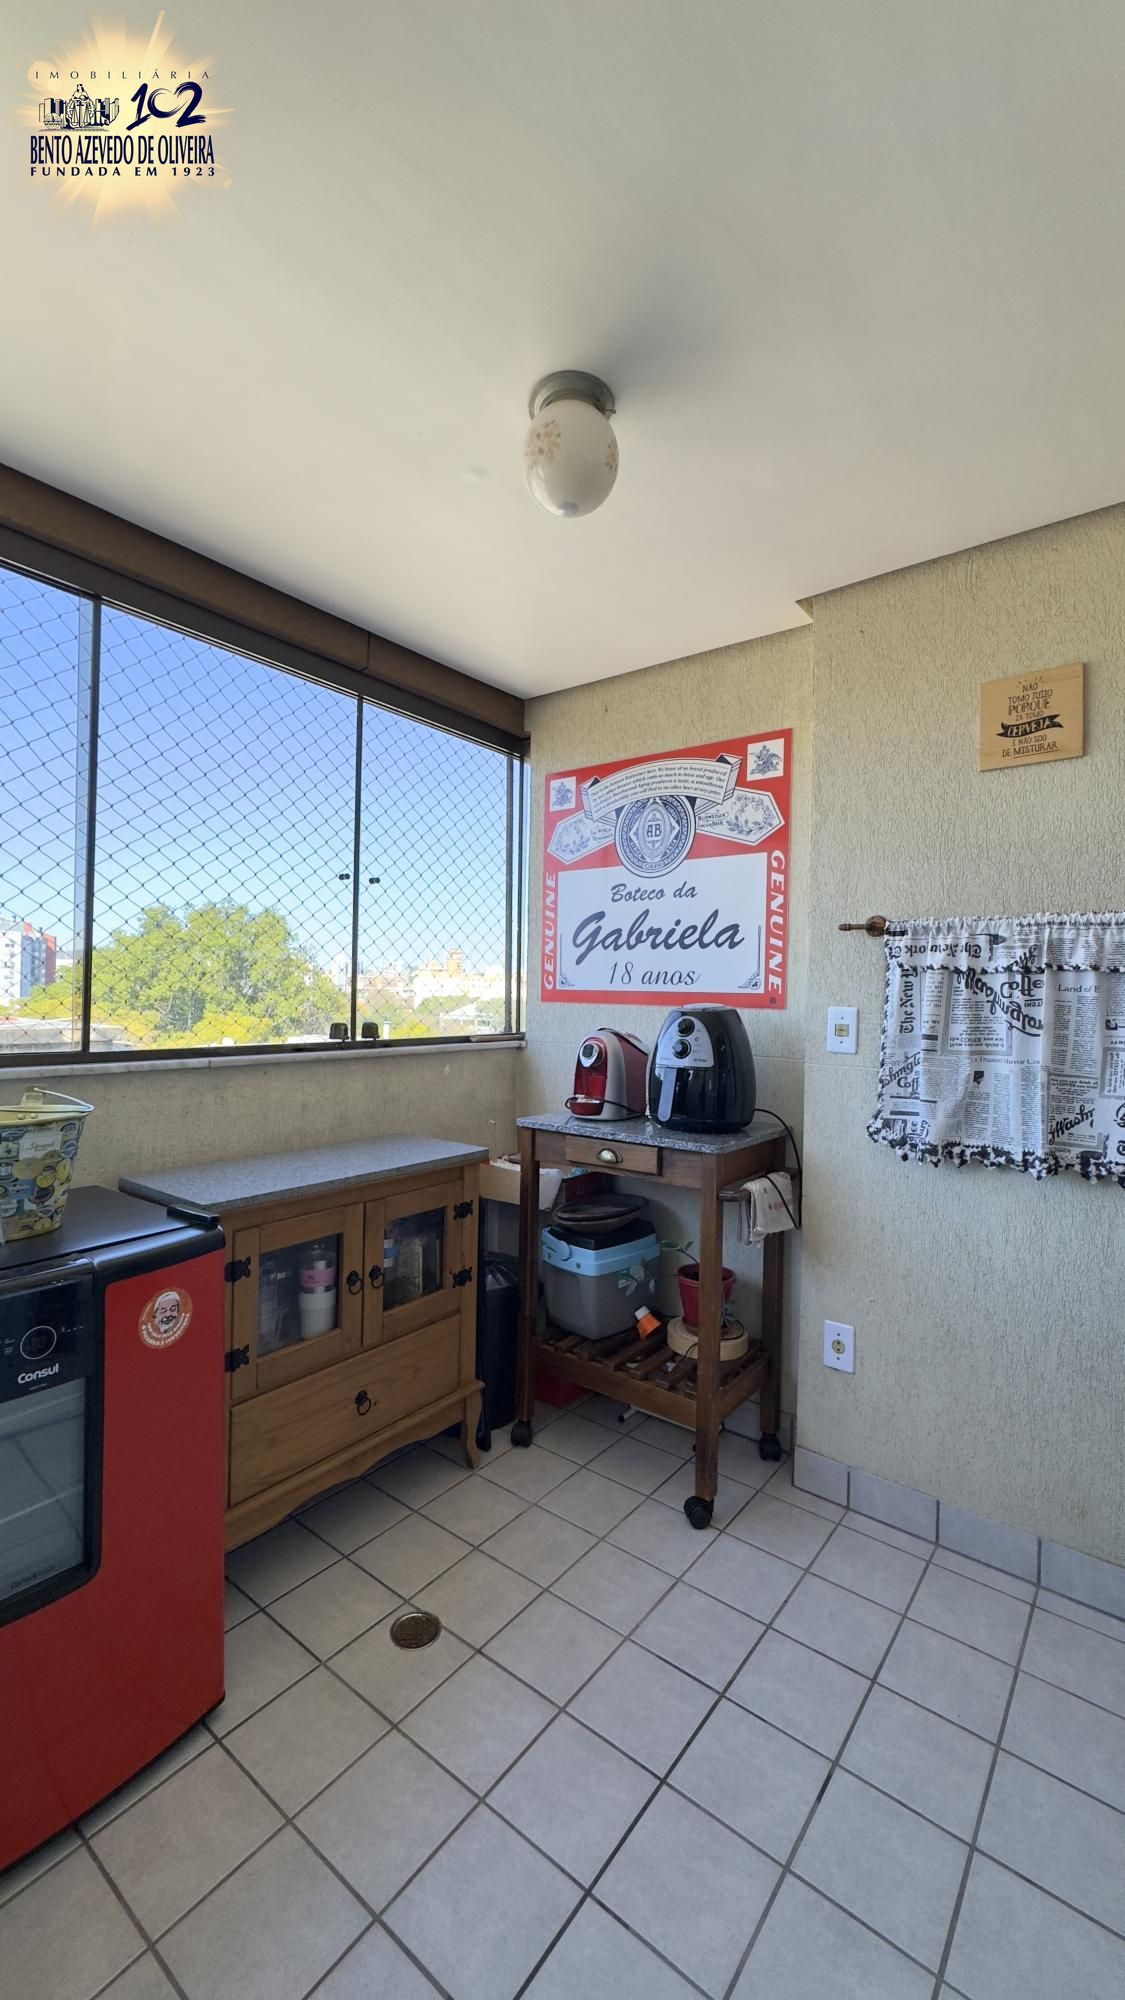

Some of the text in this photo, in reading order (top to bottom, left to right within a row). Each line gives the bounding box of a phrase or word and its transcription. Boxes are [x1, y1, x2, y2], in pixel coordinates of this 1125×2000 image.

[1008, 698, 1051, 716] PORQUE
[1007, 718, 1052, 737] CERVEJA
[1013, 740, 1058, 755] MISTURAR
[646, 823, 662, 838] AB
[611, 881, 698, 903] Boteco da
[543, 872, 556, 990] GENUINE
[768, 850, 785, 995] GENUINE
[572, 908, 745, 965] Gabriela
[608, 962, 702, 986] 18 anos
[900, 981, 915, 1008] New
[1058, 984, 1082, 993] Land
[900, 1010, 915, 1034] The
[17, 1363, 59, 1384] Consul
